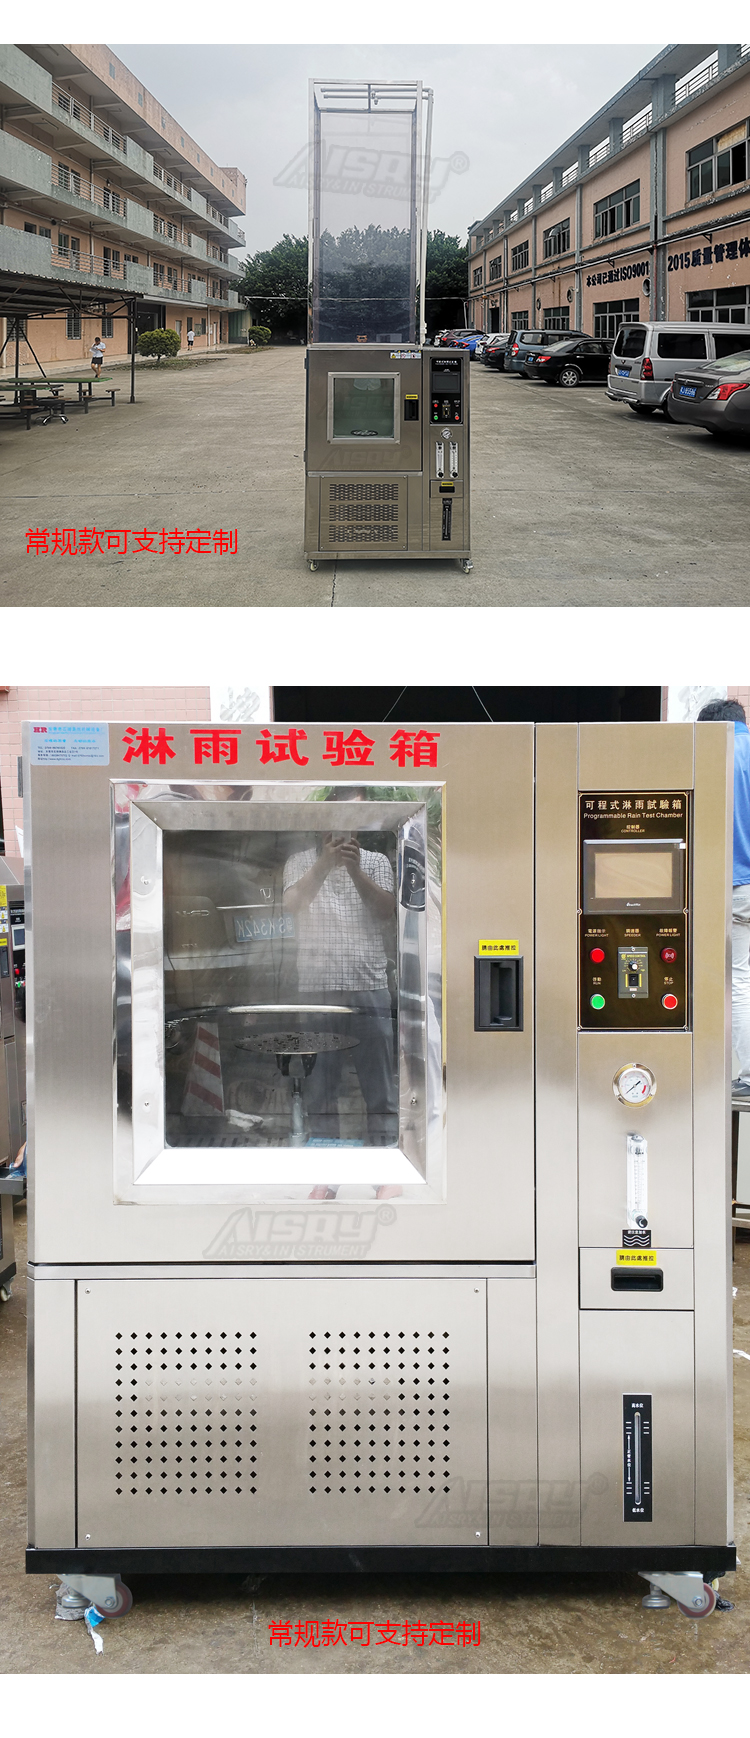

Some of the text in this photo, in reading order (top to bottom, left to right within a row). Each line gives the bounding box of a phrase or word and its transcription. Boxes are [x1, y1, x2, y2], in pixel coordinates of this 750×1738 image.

[122, 726, 441, 768] 淋雨试验箱
[585, 799, 682, 811] 可程式淋雨試驗箱
[583, 812, 627, 820] Programmable
